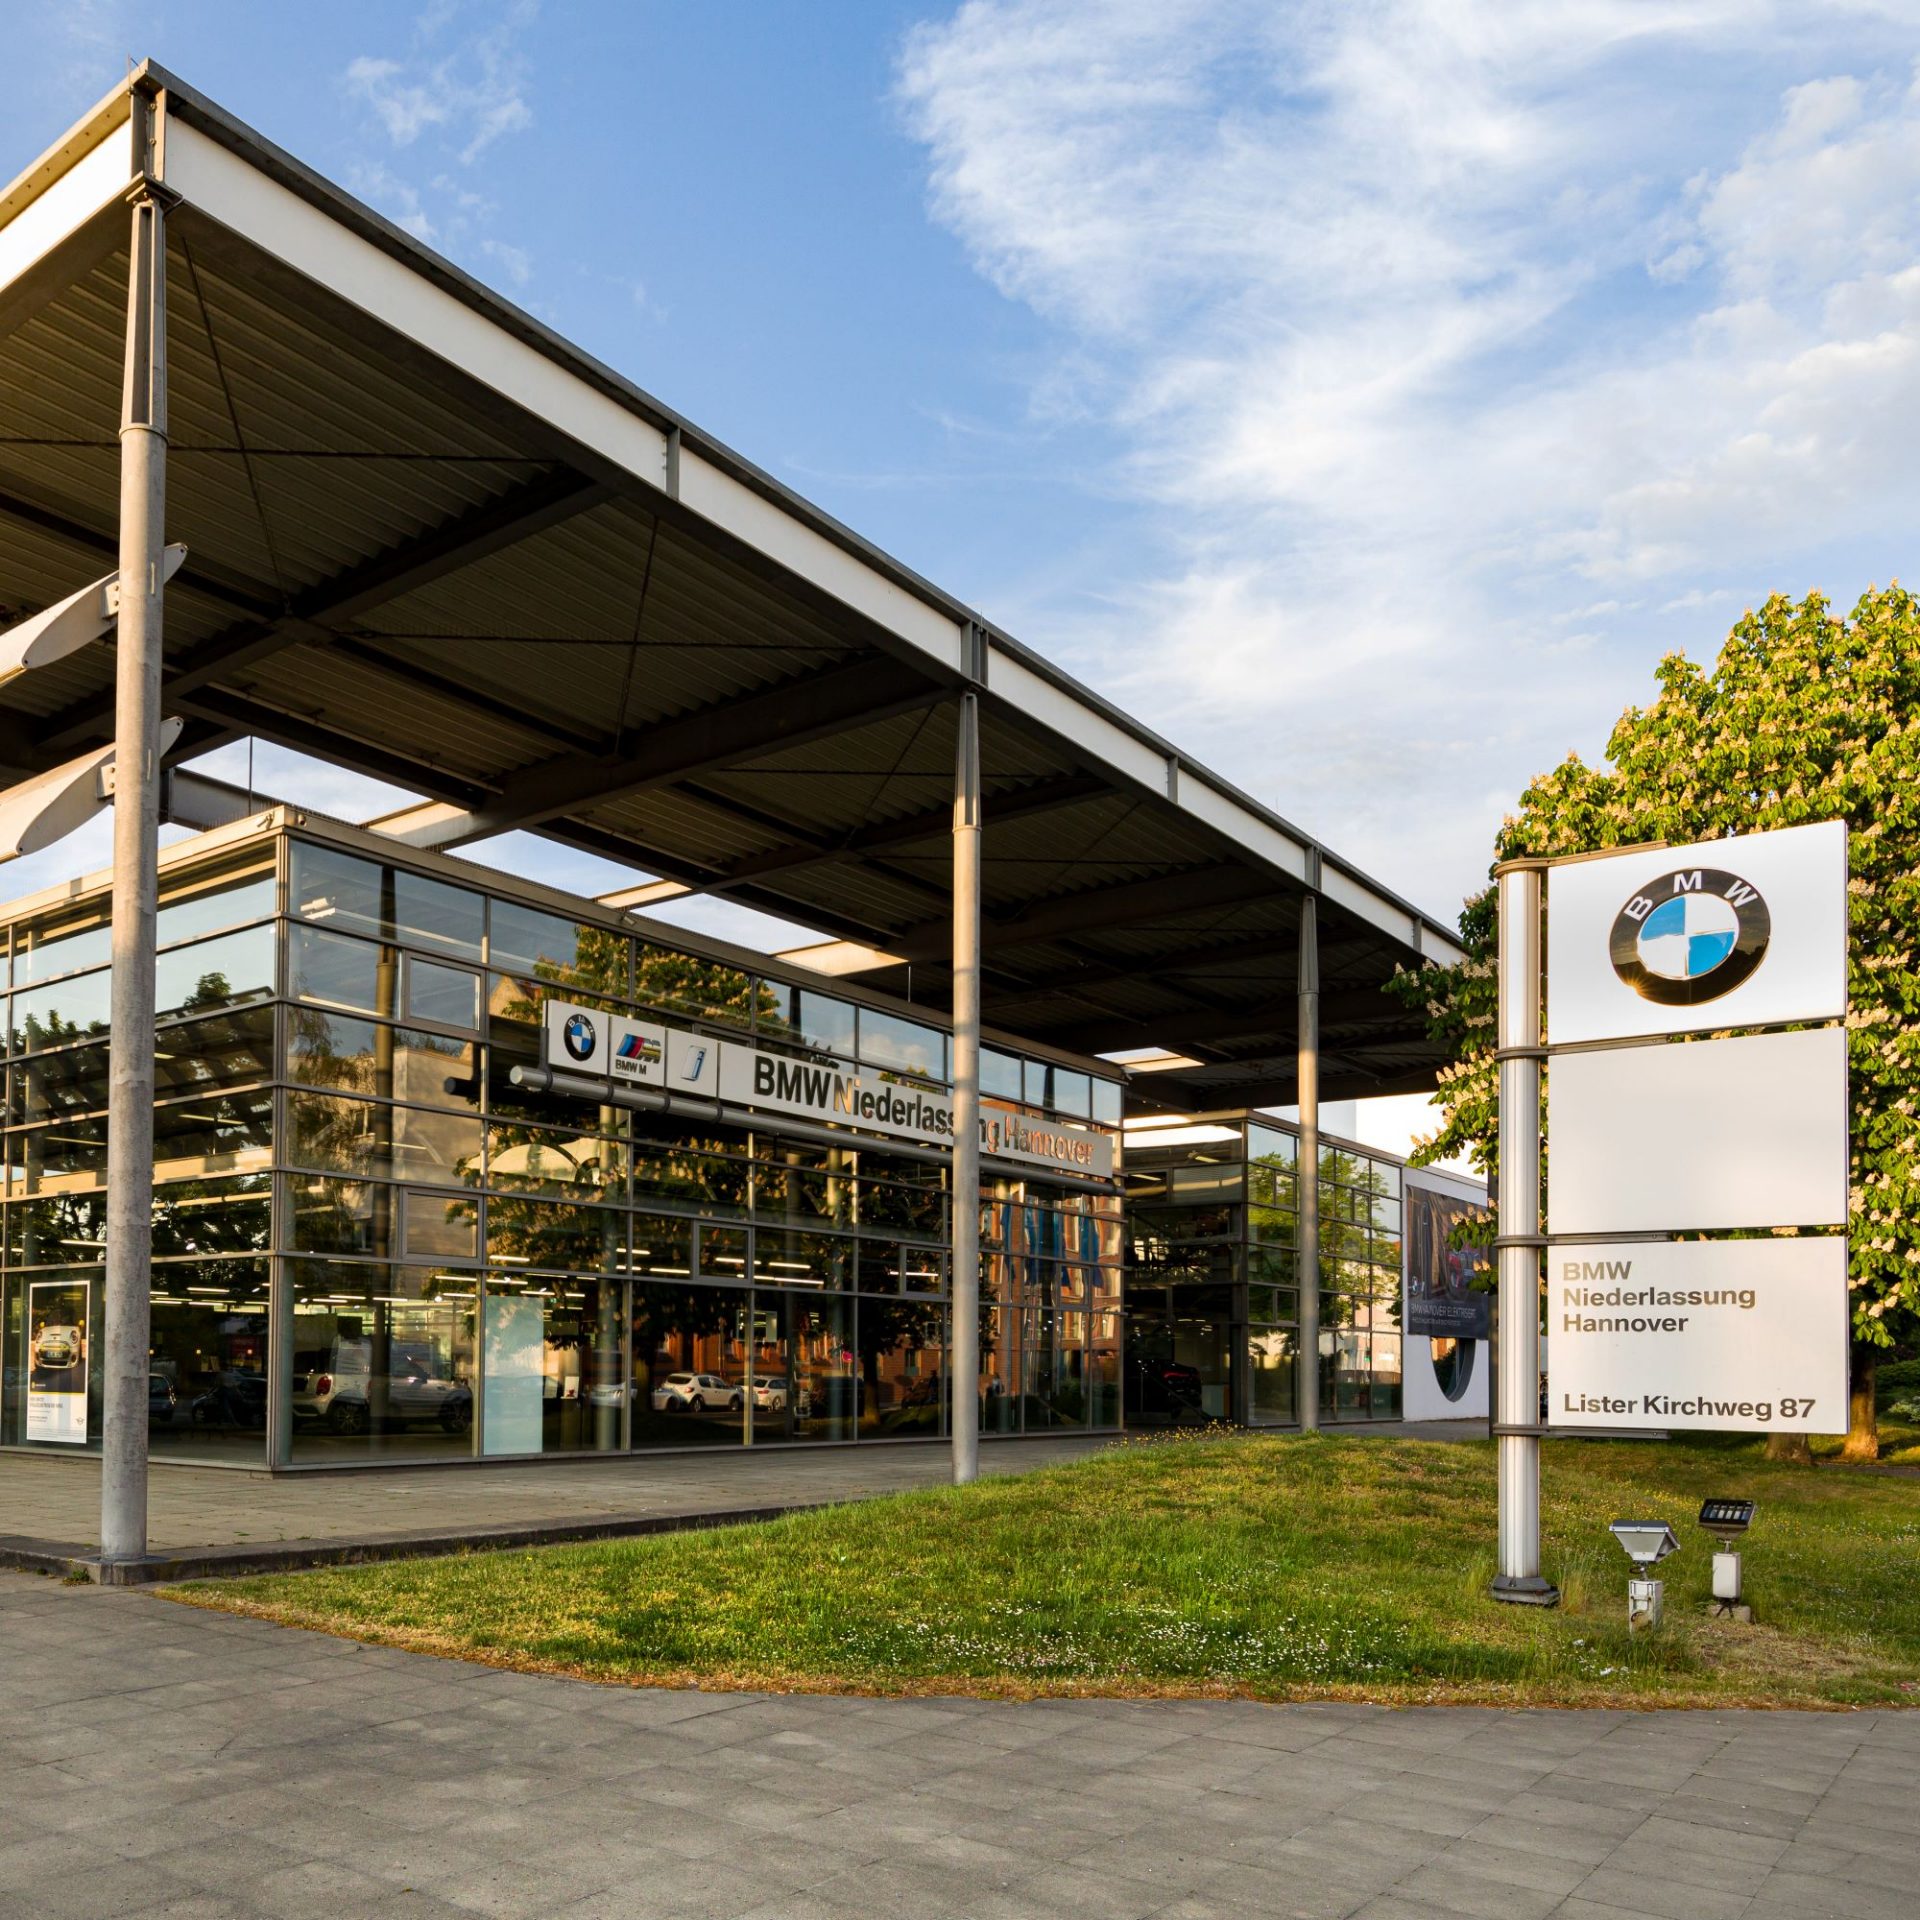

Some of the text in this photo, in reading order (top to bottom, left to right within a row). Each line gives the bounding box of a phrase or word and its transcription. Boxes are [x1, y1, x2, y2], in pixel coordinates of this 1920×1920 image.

[1624, 870, 1758, 922] BMW
[615, 1059, 638, 1073] BMW
[638, 1063, 647, 1075] M
[754, 1054, 1094, 1166] BMW Niederlasng Hannover
[1563, 1261, 1632, 1281] BMW
[1563, 1287, 1756, 1309] Niederlassung
[1563, 1313, 1689, 1333] Hannover
[1564, 1393, 1816, 1422] Lister Kirchweg 87
